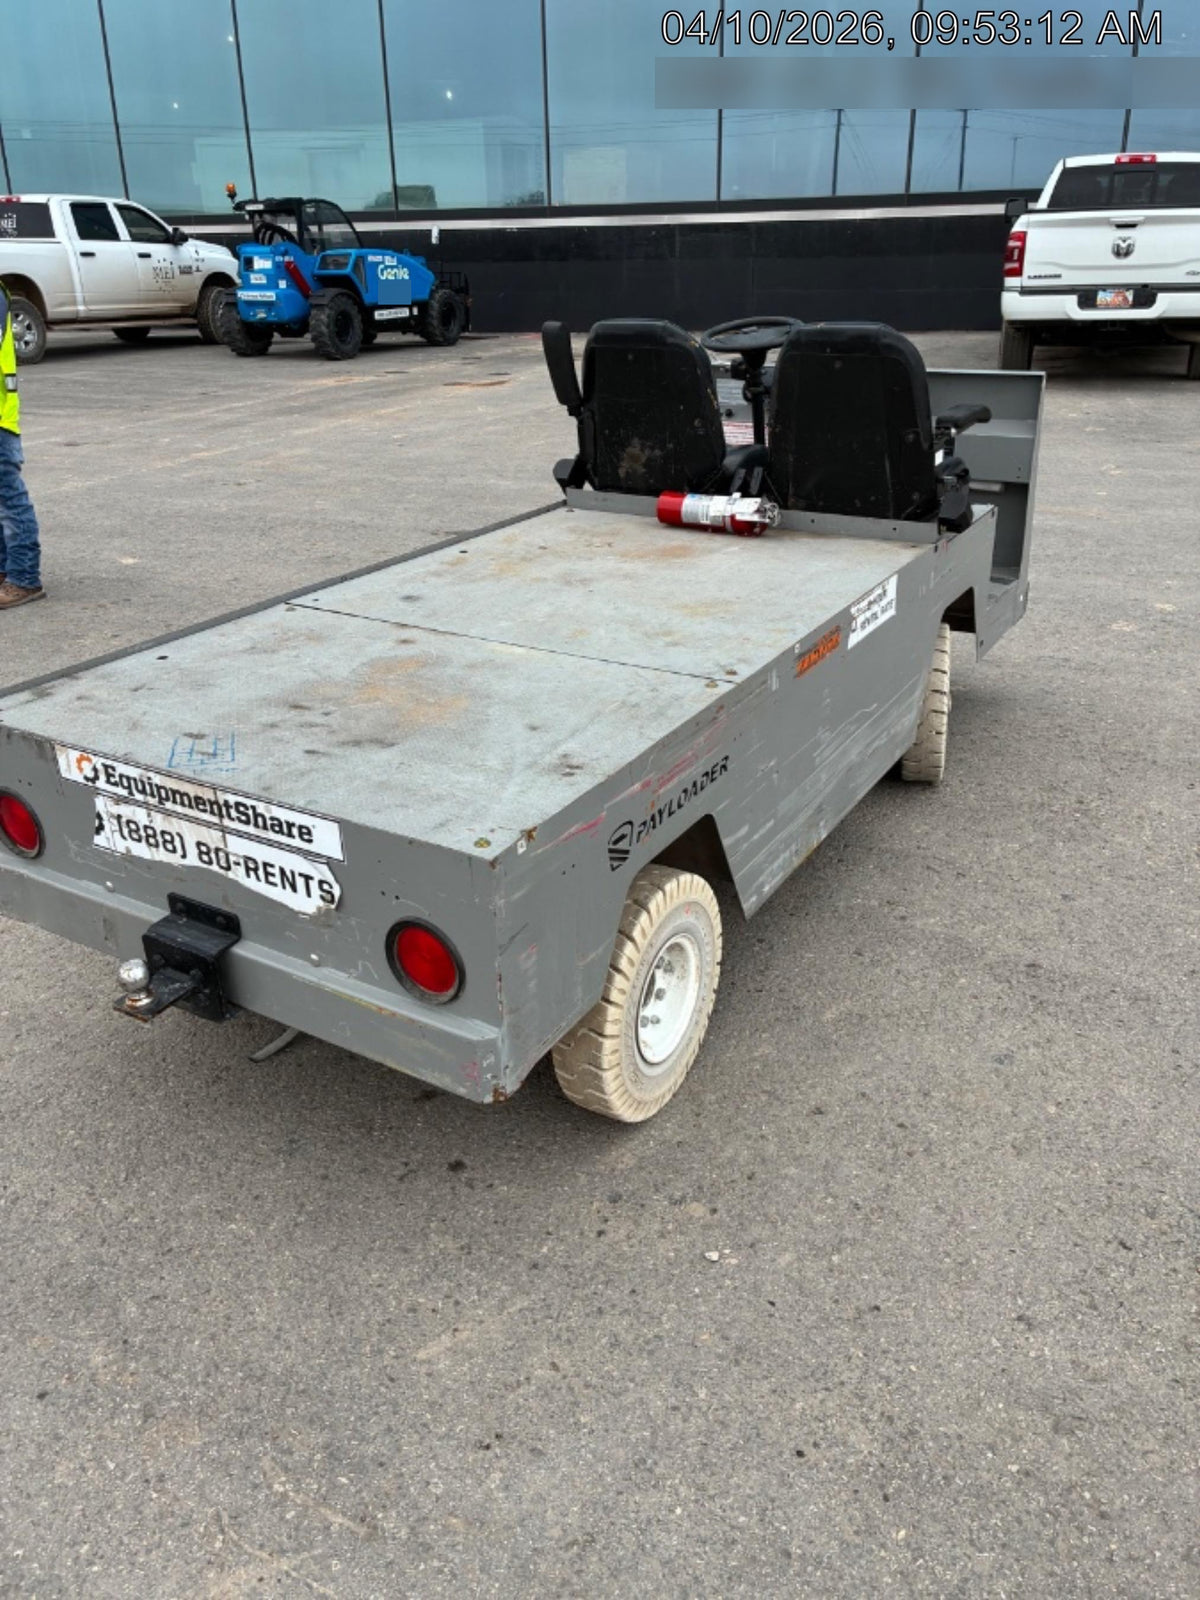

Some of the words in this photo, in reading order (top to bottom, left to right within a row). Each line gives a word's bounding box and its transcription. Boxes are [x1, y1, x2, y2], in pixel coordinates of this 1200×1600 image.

[378, 264, 410, 280] Genie
[102, 761, 315, 844] EquipmentShare
[636, 754, 730, 845] PAYLOADER
[116, 813, 188, 860] (888)
[196, 839, 337, 906] 80-RENTS
